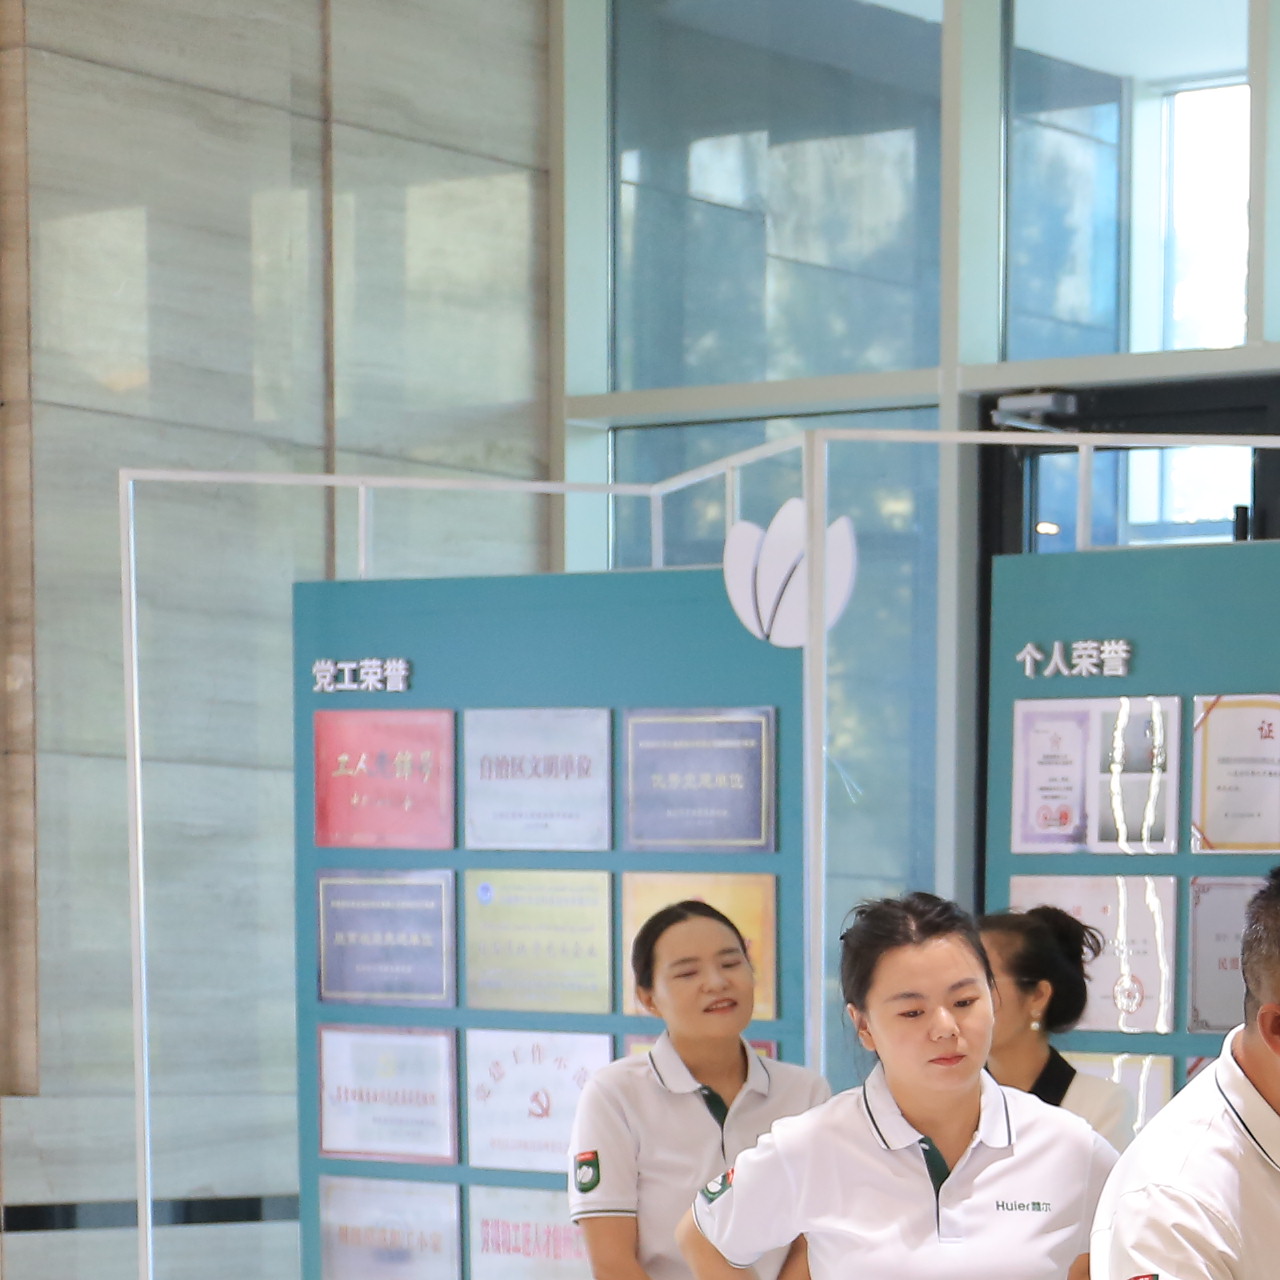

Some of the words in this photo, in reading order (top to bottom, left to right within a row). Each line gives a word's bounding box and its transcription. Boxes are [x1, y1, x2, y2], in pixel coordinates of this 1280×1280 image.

[312, 657, 411, 693] 党工荣誉
[1015, 639, 1133, 679] 个人荣誉
